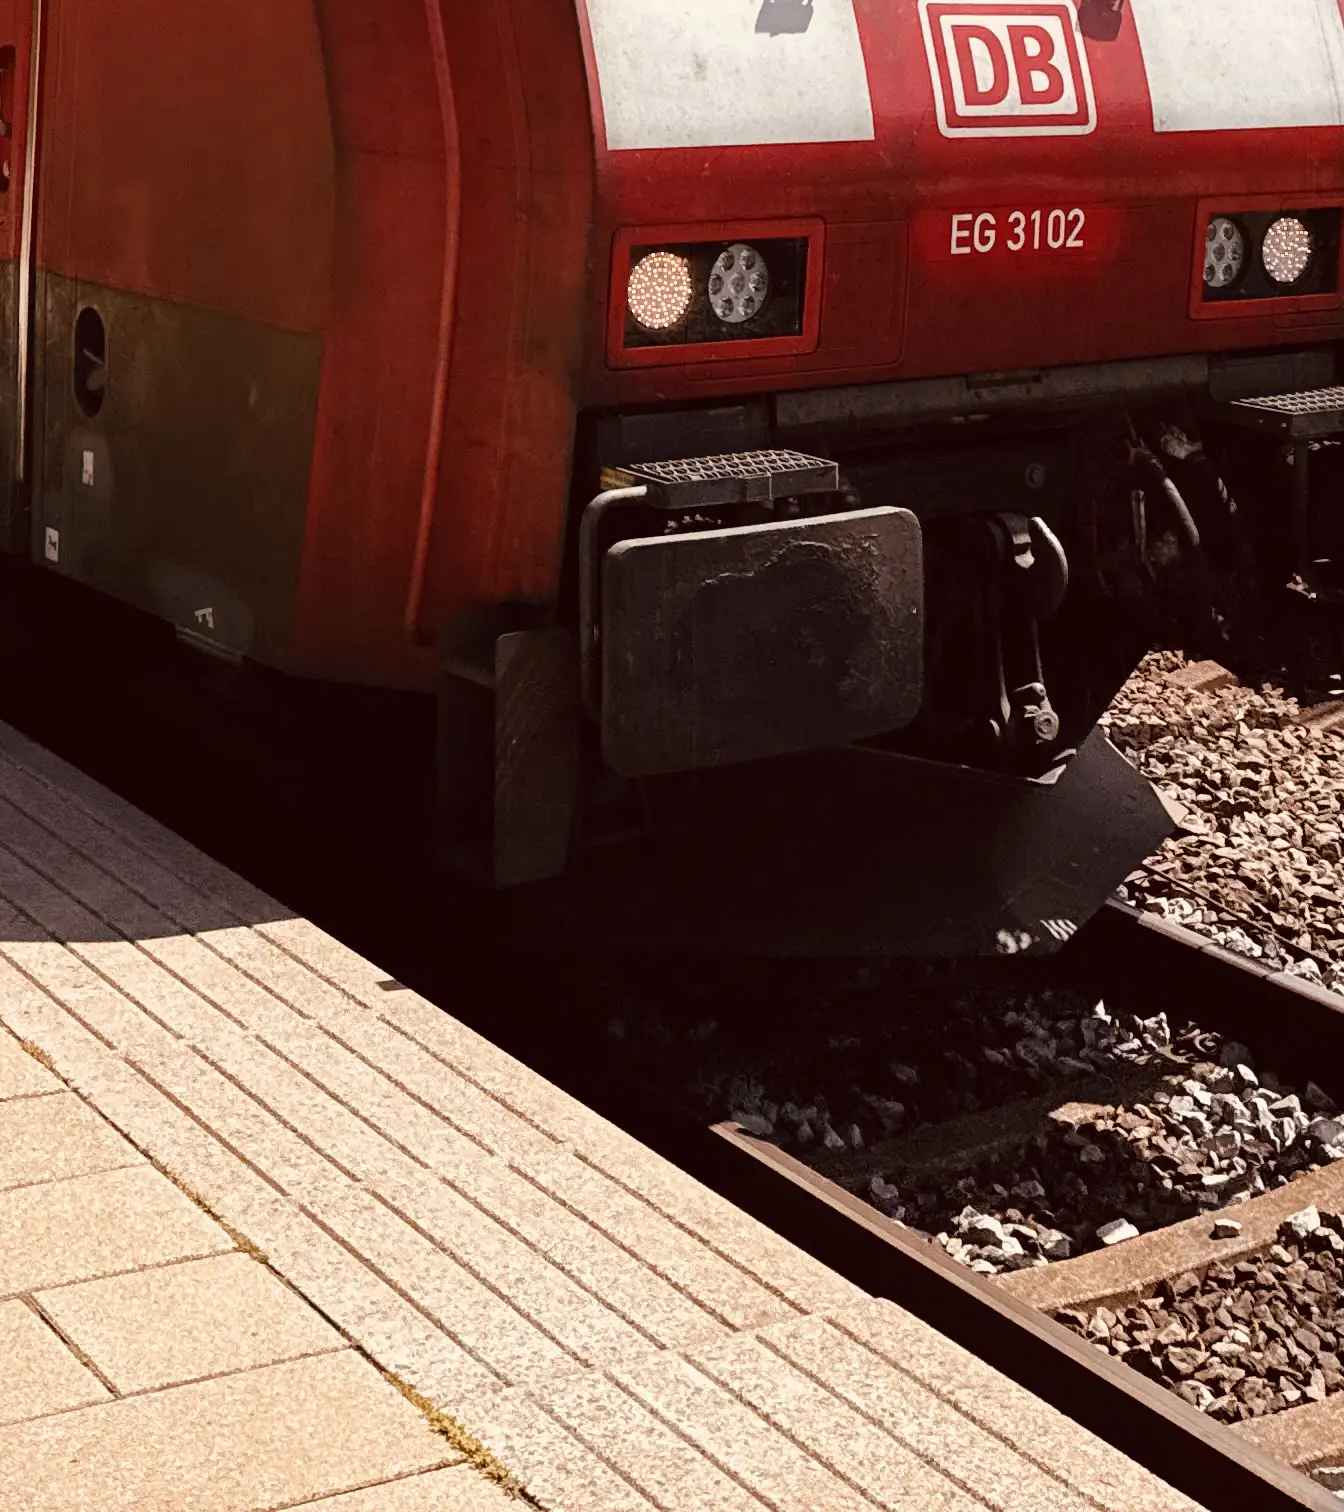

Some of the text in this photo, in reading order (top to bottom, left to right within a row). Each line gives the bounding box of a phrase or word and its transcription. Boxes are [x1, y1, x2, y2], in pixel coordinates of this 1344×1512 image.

[951, 24, 1065, 106] DB
[950, 207, 1086, 255] EG 3102
